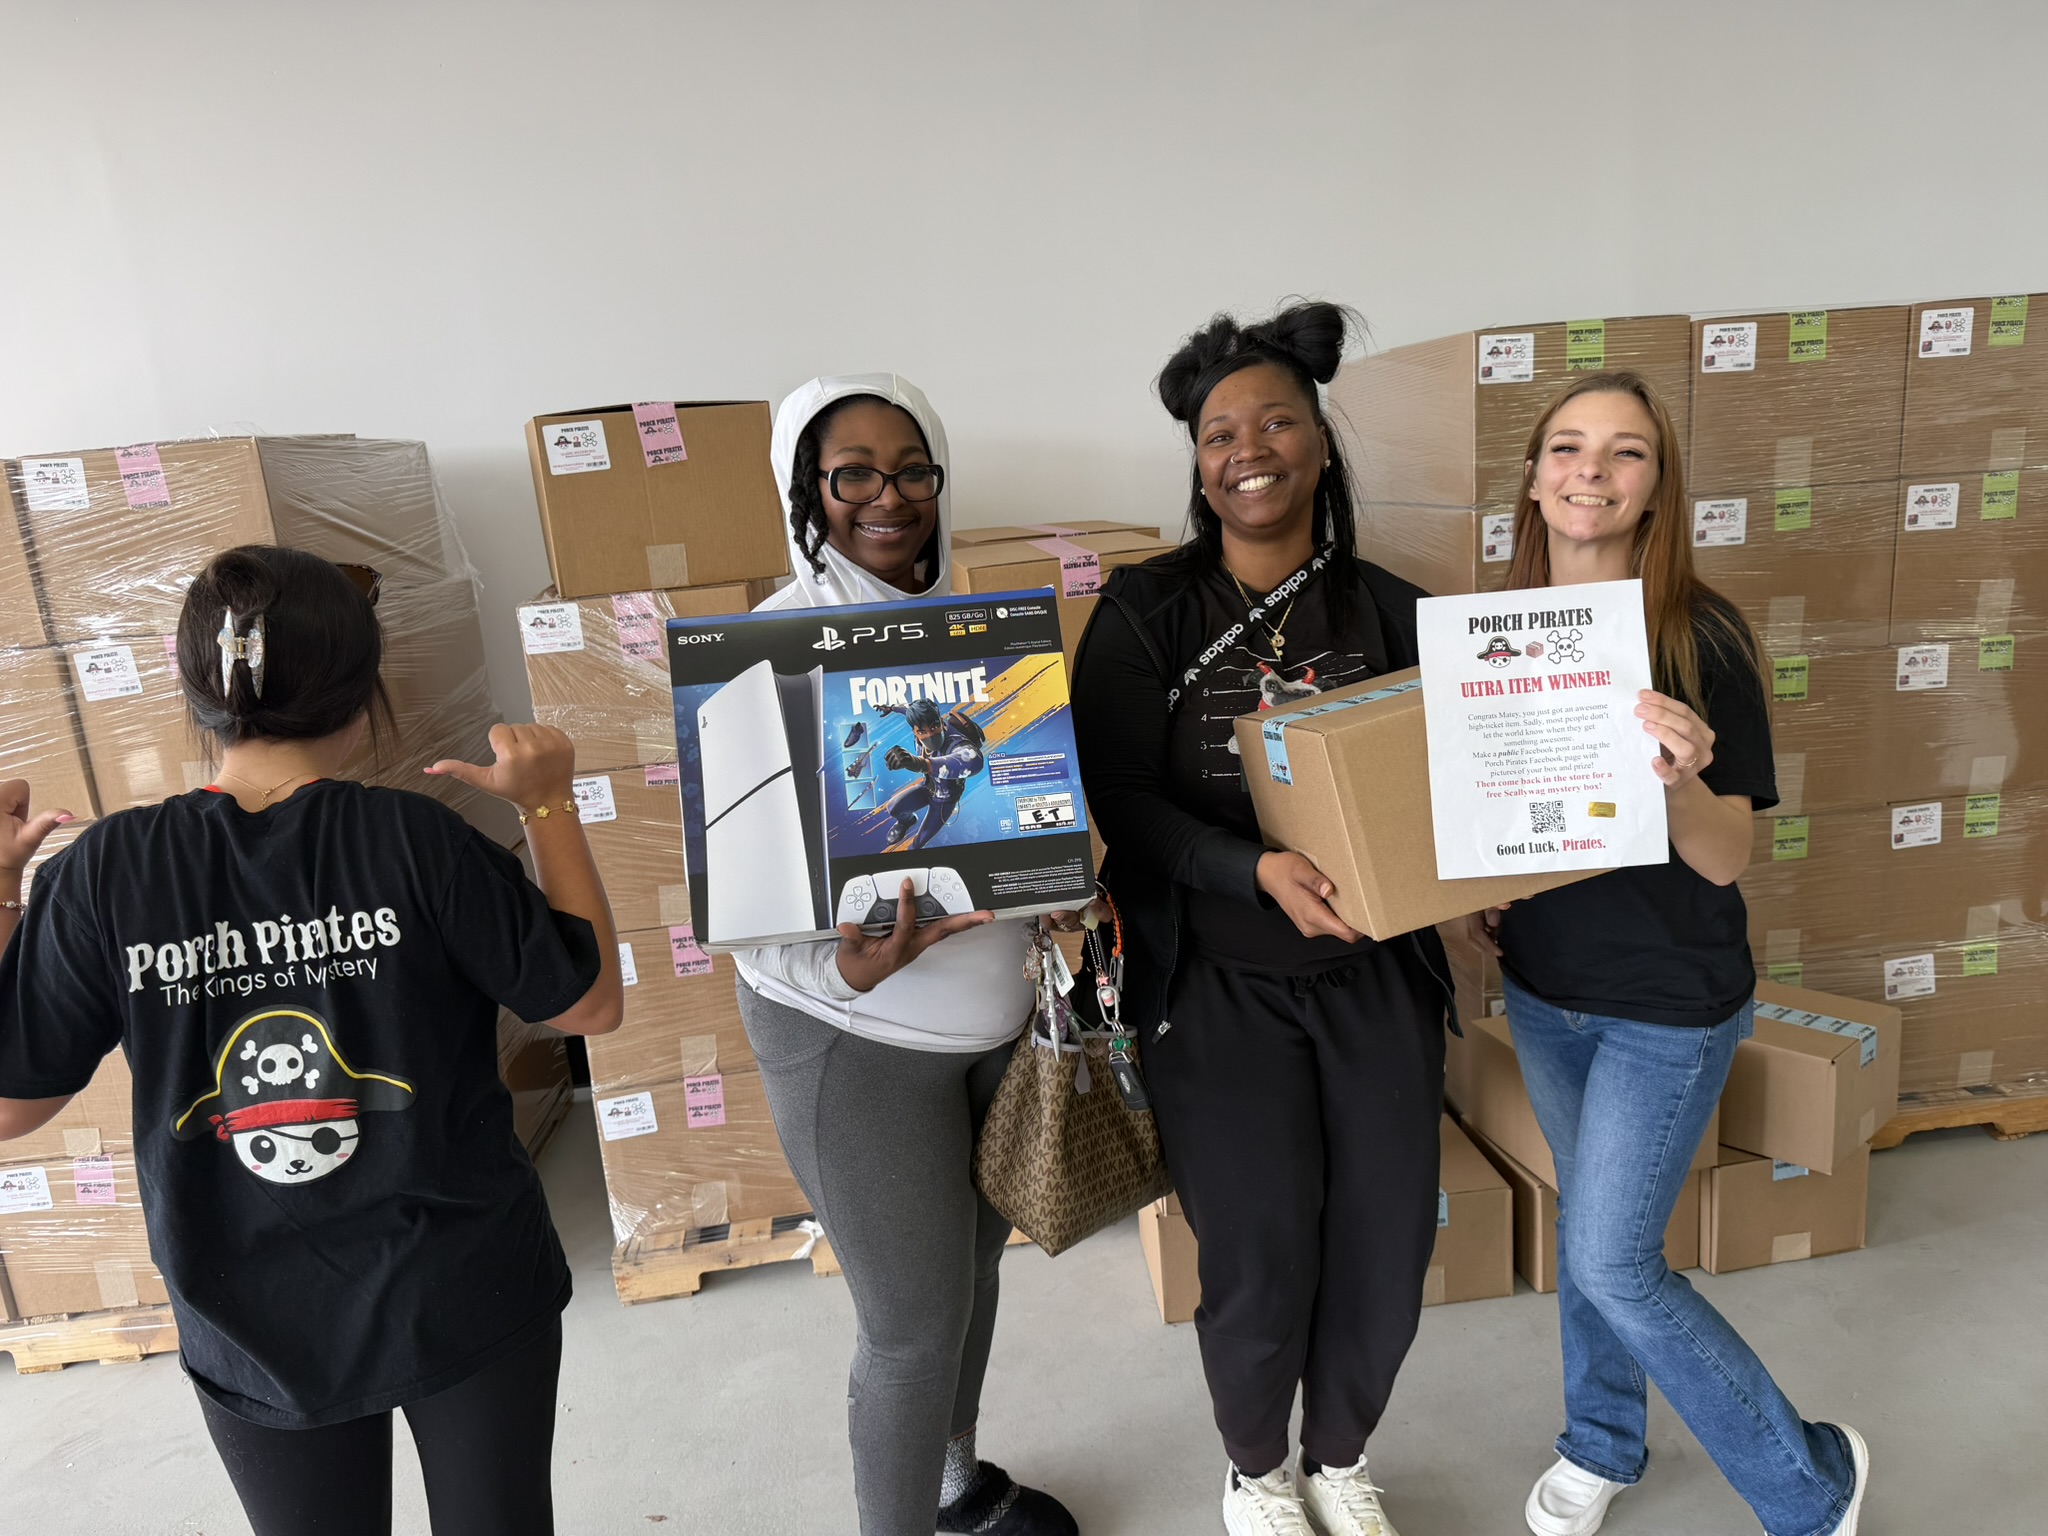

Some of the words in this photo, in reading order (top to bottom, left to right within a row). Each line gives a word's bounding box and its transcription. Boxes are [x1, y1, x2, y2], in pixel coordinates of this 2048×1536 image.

[657, 417, 675, 425] PIRATES
[664, 446, 682, 454] PIRATES
[1264, 569, 1308, 607] adidas
[1468, 614, 1522, 634] PORCH
[1528, 608, 1593, 629] PIRATES
[678, 633, 723, 645] SONY
[852, 623, 924, 644] PS5
[1199, 623, 1244, 666] adidas
[849, 666, 989, 715] FORTNITE
[1461, 680, 1504, 698] ULTRA
[1508, 676, 1543, 694] ITEM
[1548, 670, 1611, 691] WINNER!
[1468, 713, 1497, 721] Congrats
[1499, 711, 1521, 719] Matey,
[1537, 709, 1550, 717] just
[1575, 703, 1608, 711] awesome
[1469, 722, 1504, 730] high-ticket
[1498, 749, 1519, 758] public
[1521, 747, 1553, 755] Facebook
[1490, 769, 1516, 778] pictures
[1527, 768, 1542, 776] your
[1574, 762, 1593, 770] prize!
[1521, 776, 1540, 784] back
[1504, 787, 1545, 798] Scallywag
[1548, 784, 1581, 795] mystery
[1584, 782, 1602, 790] box!
[1497, 842, 1525, 856] Good
[1529, 841, 1559, 854] Luck,
[1562, 837, 1606, 851] Pirates.
[126, 921, 248, 992] Porch
[160, 984, 200, 1006] The
[274, 967, 295, 987] of
[1047, 1065, 1068, 1078] MK
[1134, 1112, 1151, 1122] MK
[1046, 1181, 1066, 1193] MK
[1039, 1208, 1060, 1219] MK
